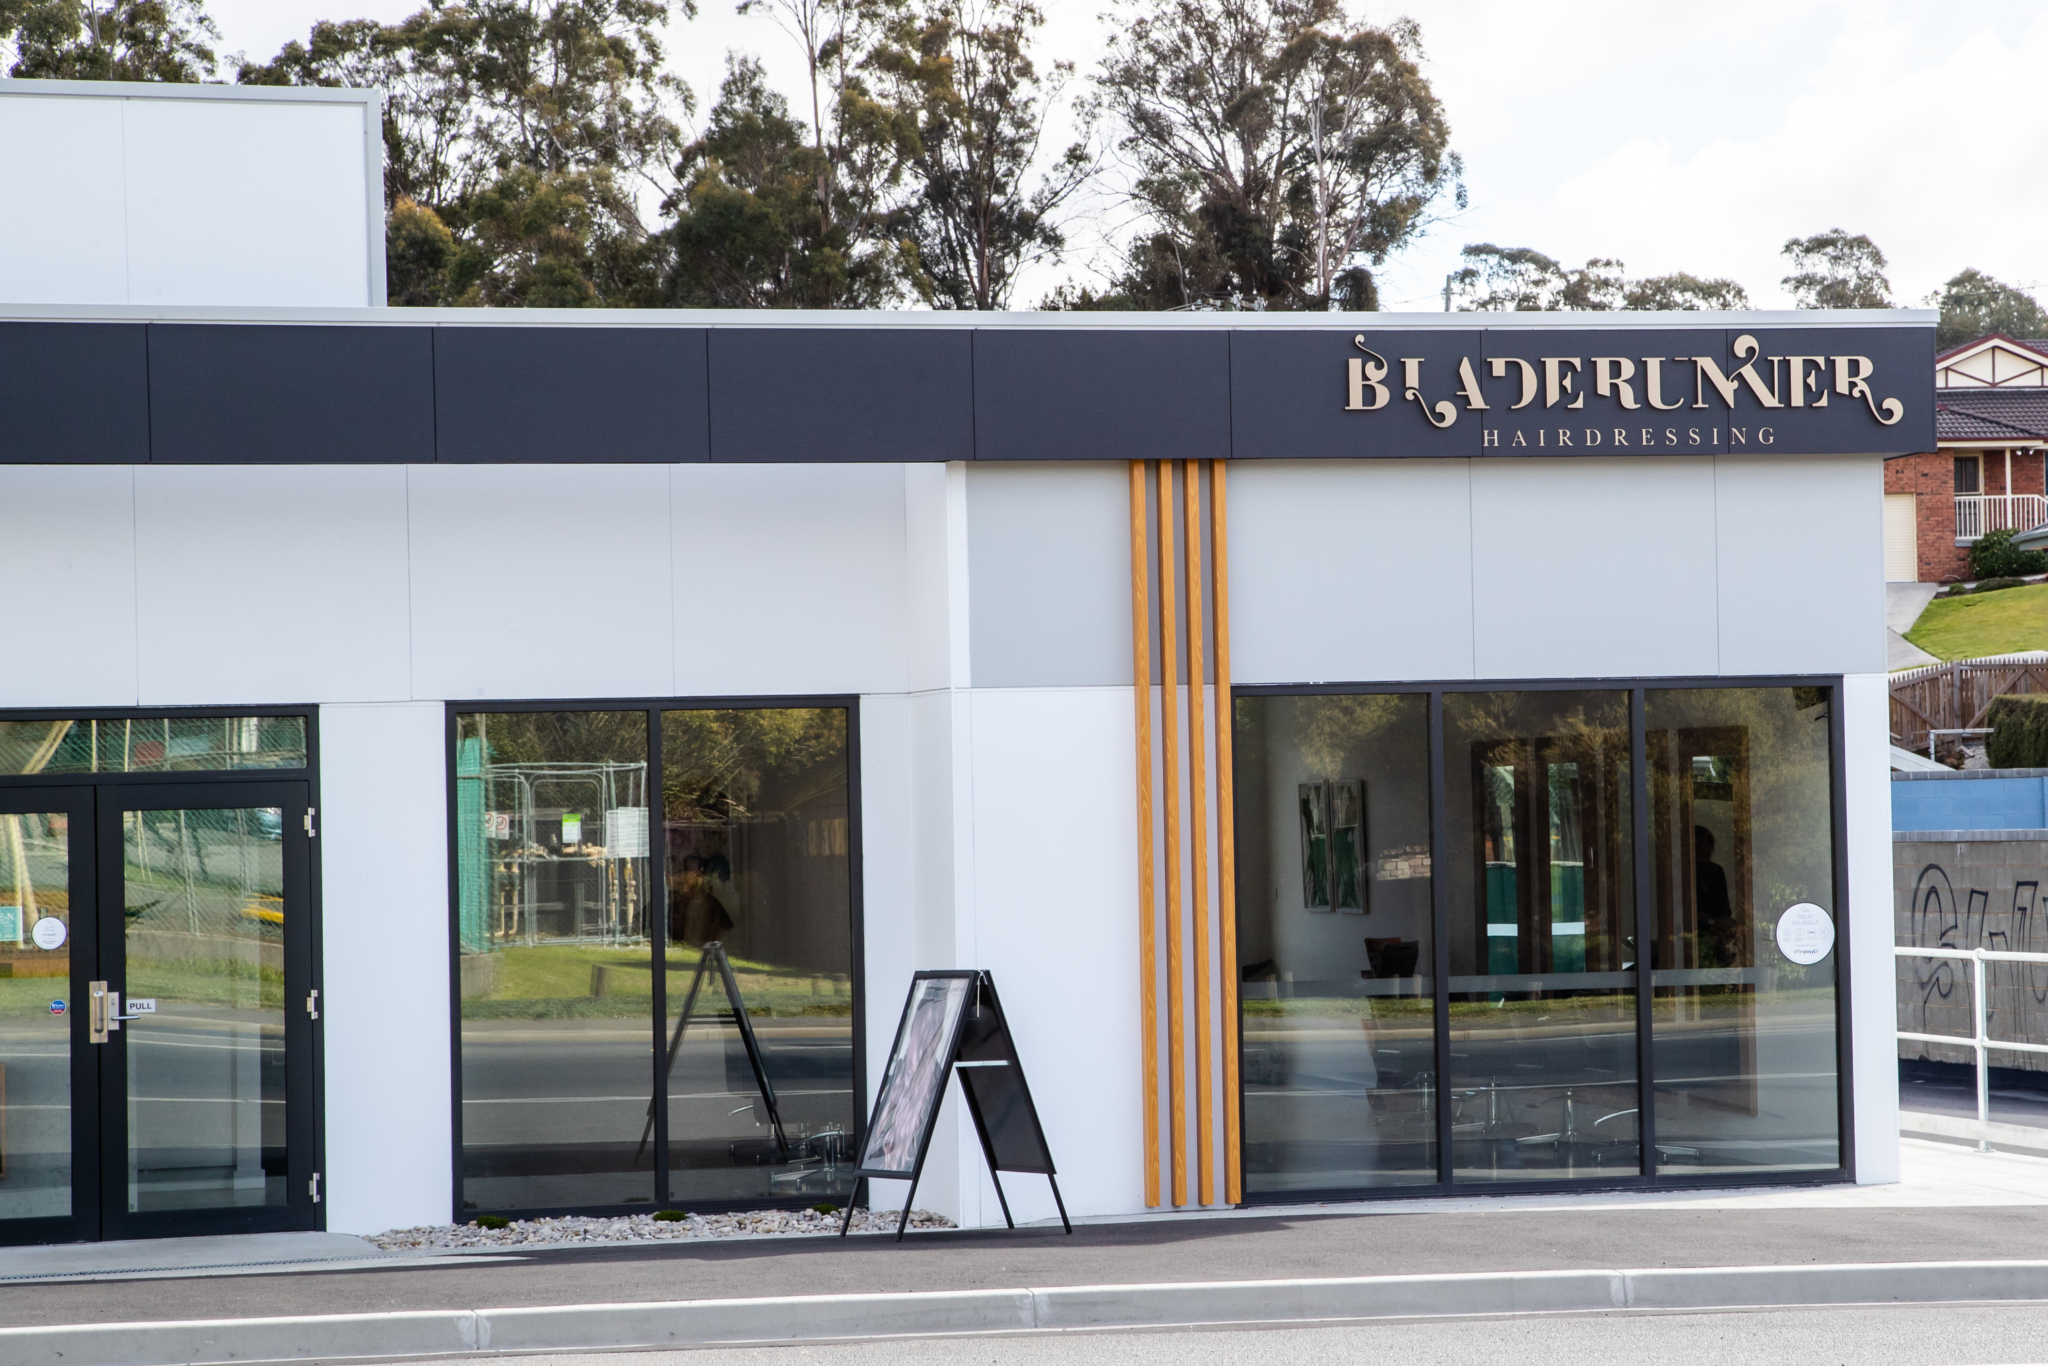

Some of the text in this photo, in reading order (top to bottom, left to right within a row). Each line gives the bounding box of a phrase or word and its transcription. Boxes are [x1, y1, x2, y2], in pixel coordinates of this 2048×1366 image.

[1344, 333, 1904, 428] BLADERUNNER
[1482, 427, 1776, 447] HAIRDRESSING
[129, 1002, 152, 1010] PULL
